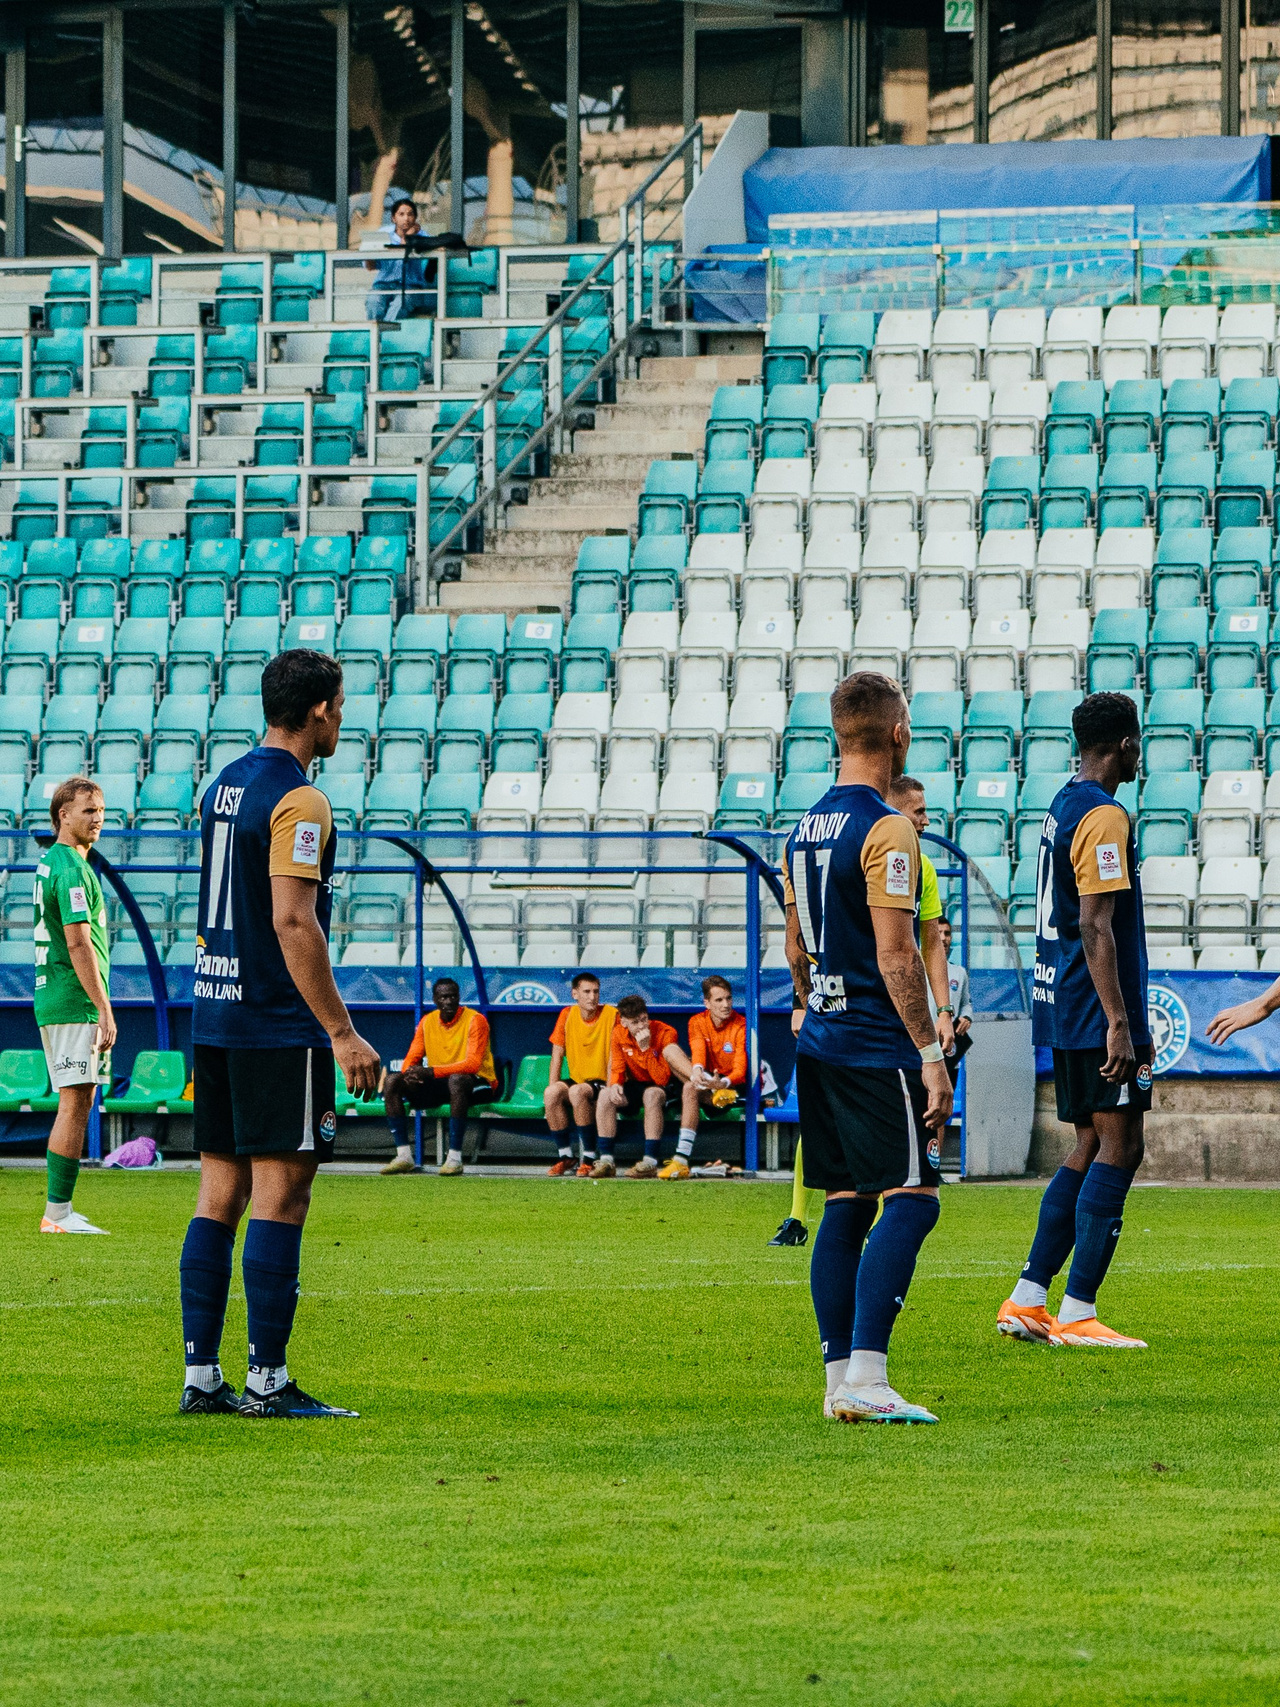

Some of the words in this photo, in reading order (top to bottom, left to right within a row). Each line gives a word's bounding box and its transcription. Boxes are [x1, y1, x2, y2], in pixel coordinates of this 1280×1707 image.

[947, 1, 973, 27] 22
[793, 849, 832, 953] 17
[194, 946, 240, 978] Fama
[505, 987, 549, 1004] EESTI
[186, 1341, 195, 1354] 11
[249, 1343, 256, 1356] 11
